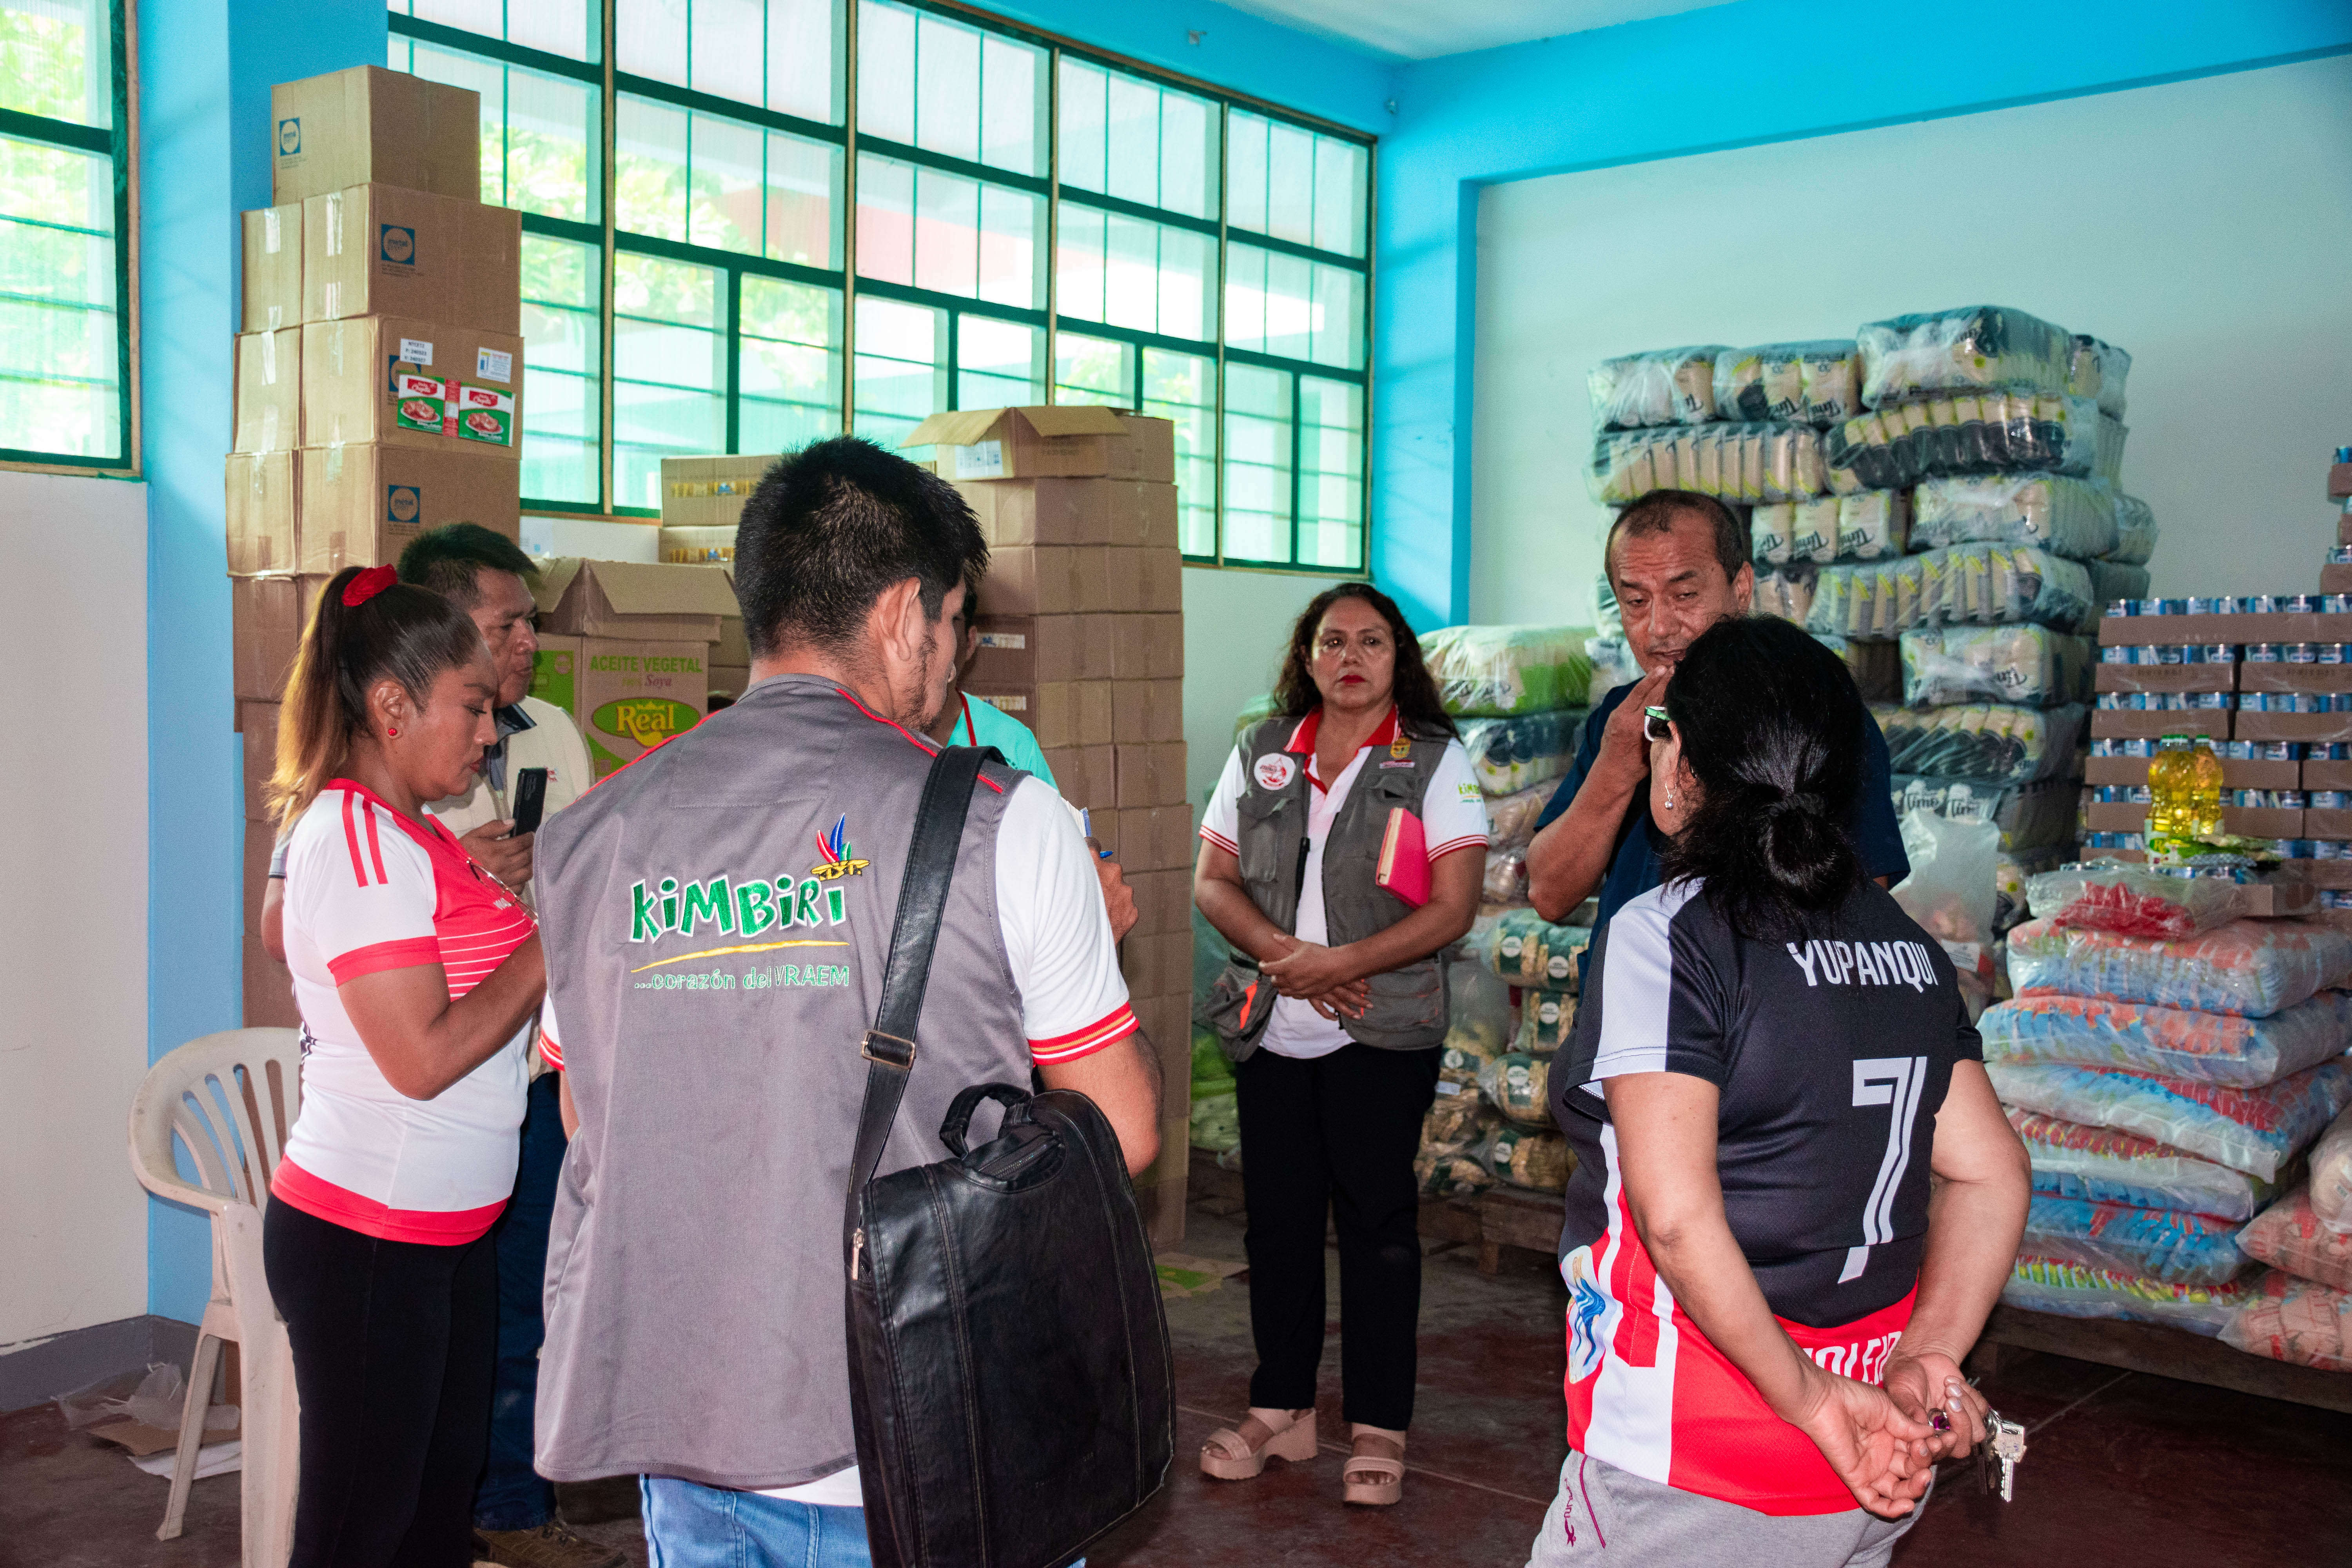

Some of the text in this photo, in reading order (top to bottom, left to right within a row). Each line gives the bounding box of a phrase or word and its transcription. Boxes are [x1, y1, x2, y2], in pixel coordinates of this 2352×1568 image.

[590, 655, 639, 671] ACEITE
[643, 657, 703, 673] VEGETAL
[645, 674, 672, 689] Soya
[617, 704, 675, 747] Real
[744, 966, 771, 988] del
[775, 965, 850, 987] VRAEM
[1786, 939, 1938, 993] YUPANQUI
[1838, 1056, 1928, 1284] 7
